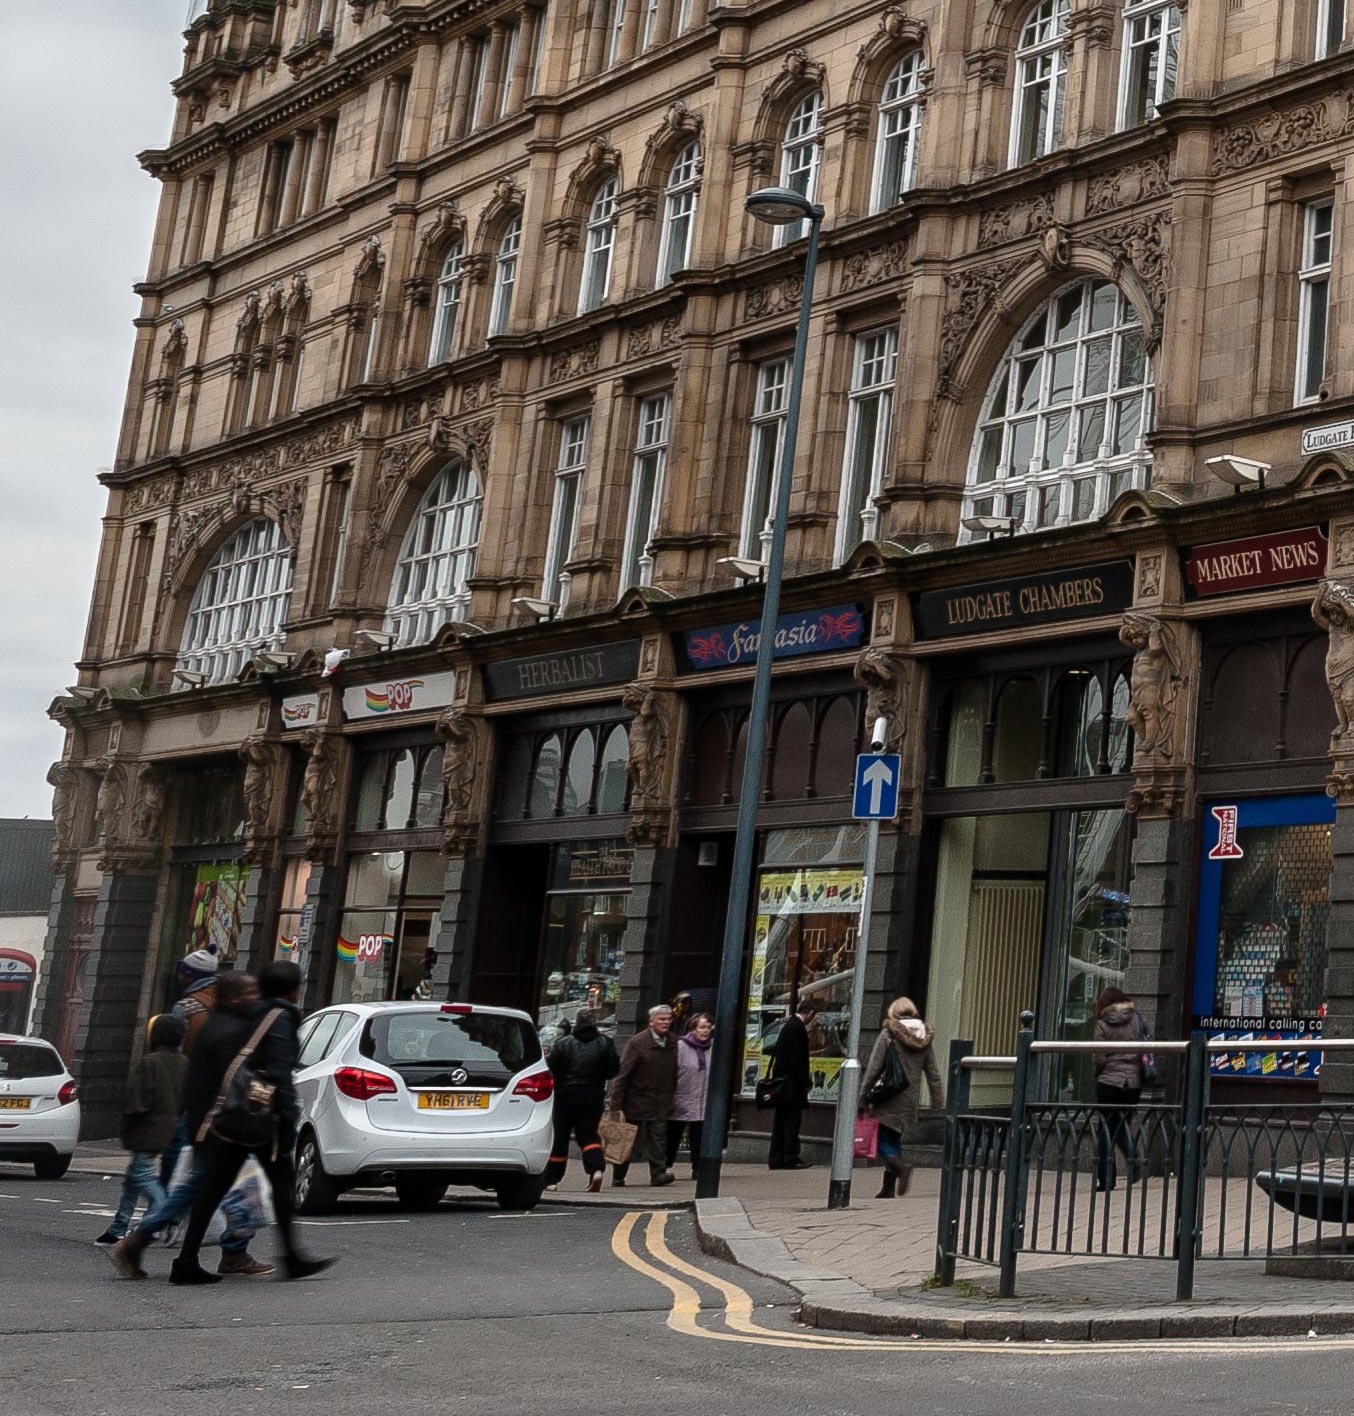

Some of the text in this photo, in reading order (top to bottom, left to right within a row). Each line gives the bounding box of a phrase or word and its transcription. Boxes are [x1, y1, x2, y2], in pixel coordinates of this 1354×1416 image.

[1197, 541, 1319, 583] MARKET NEWS
[948, 578, 1104, 624] LUDGATE CHAMBERS
[518, 652, 606, 689] HERBALIST
[387, 684, 412, 709] POP
[1227, 810, 1235, 854] FIRST
[358, 935, 383, 956] POP
[1200, 1017, 1265, 1027] international
[1269, 1017, 1305, 1032] calling
